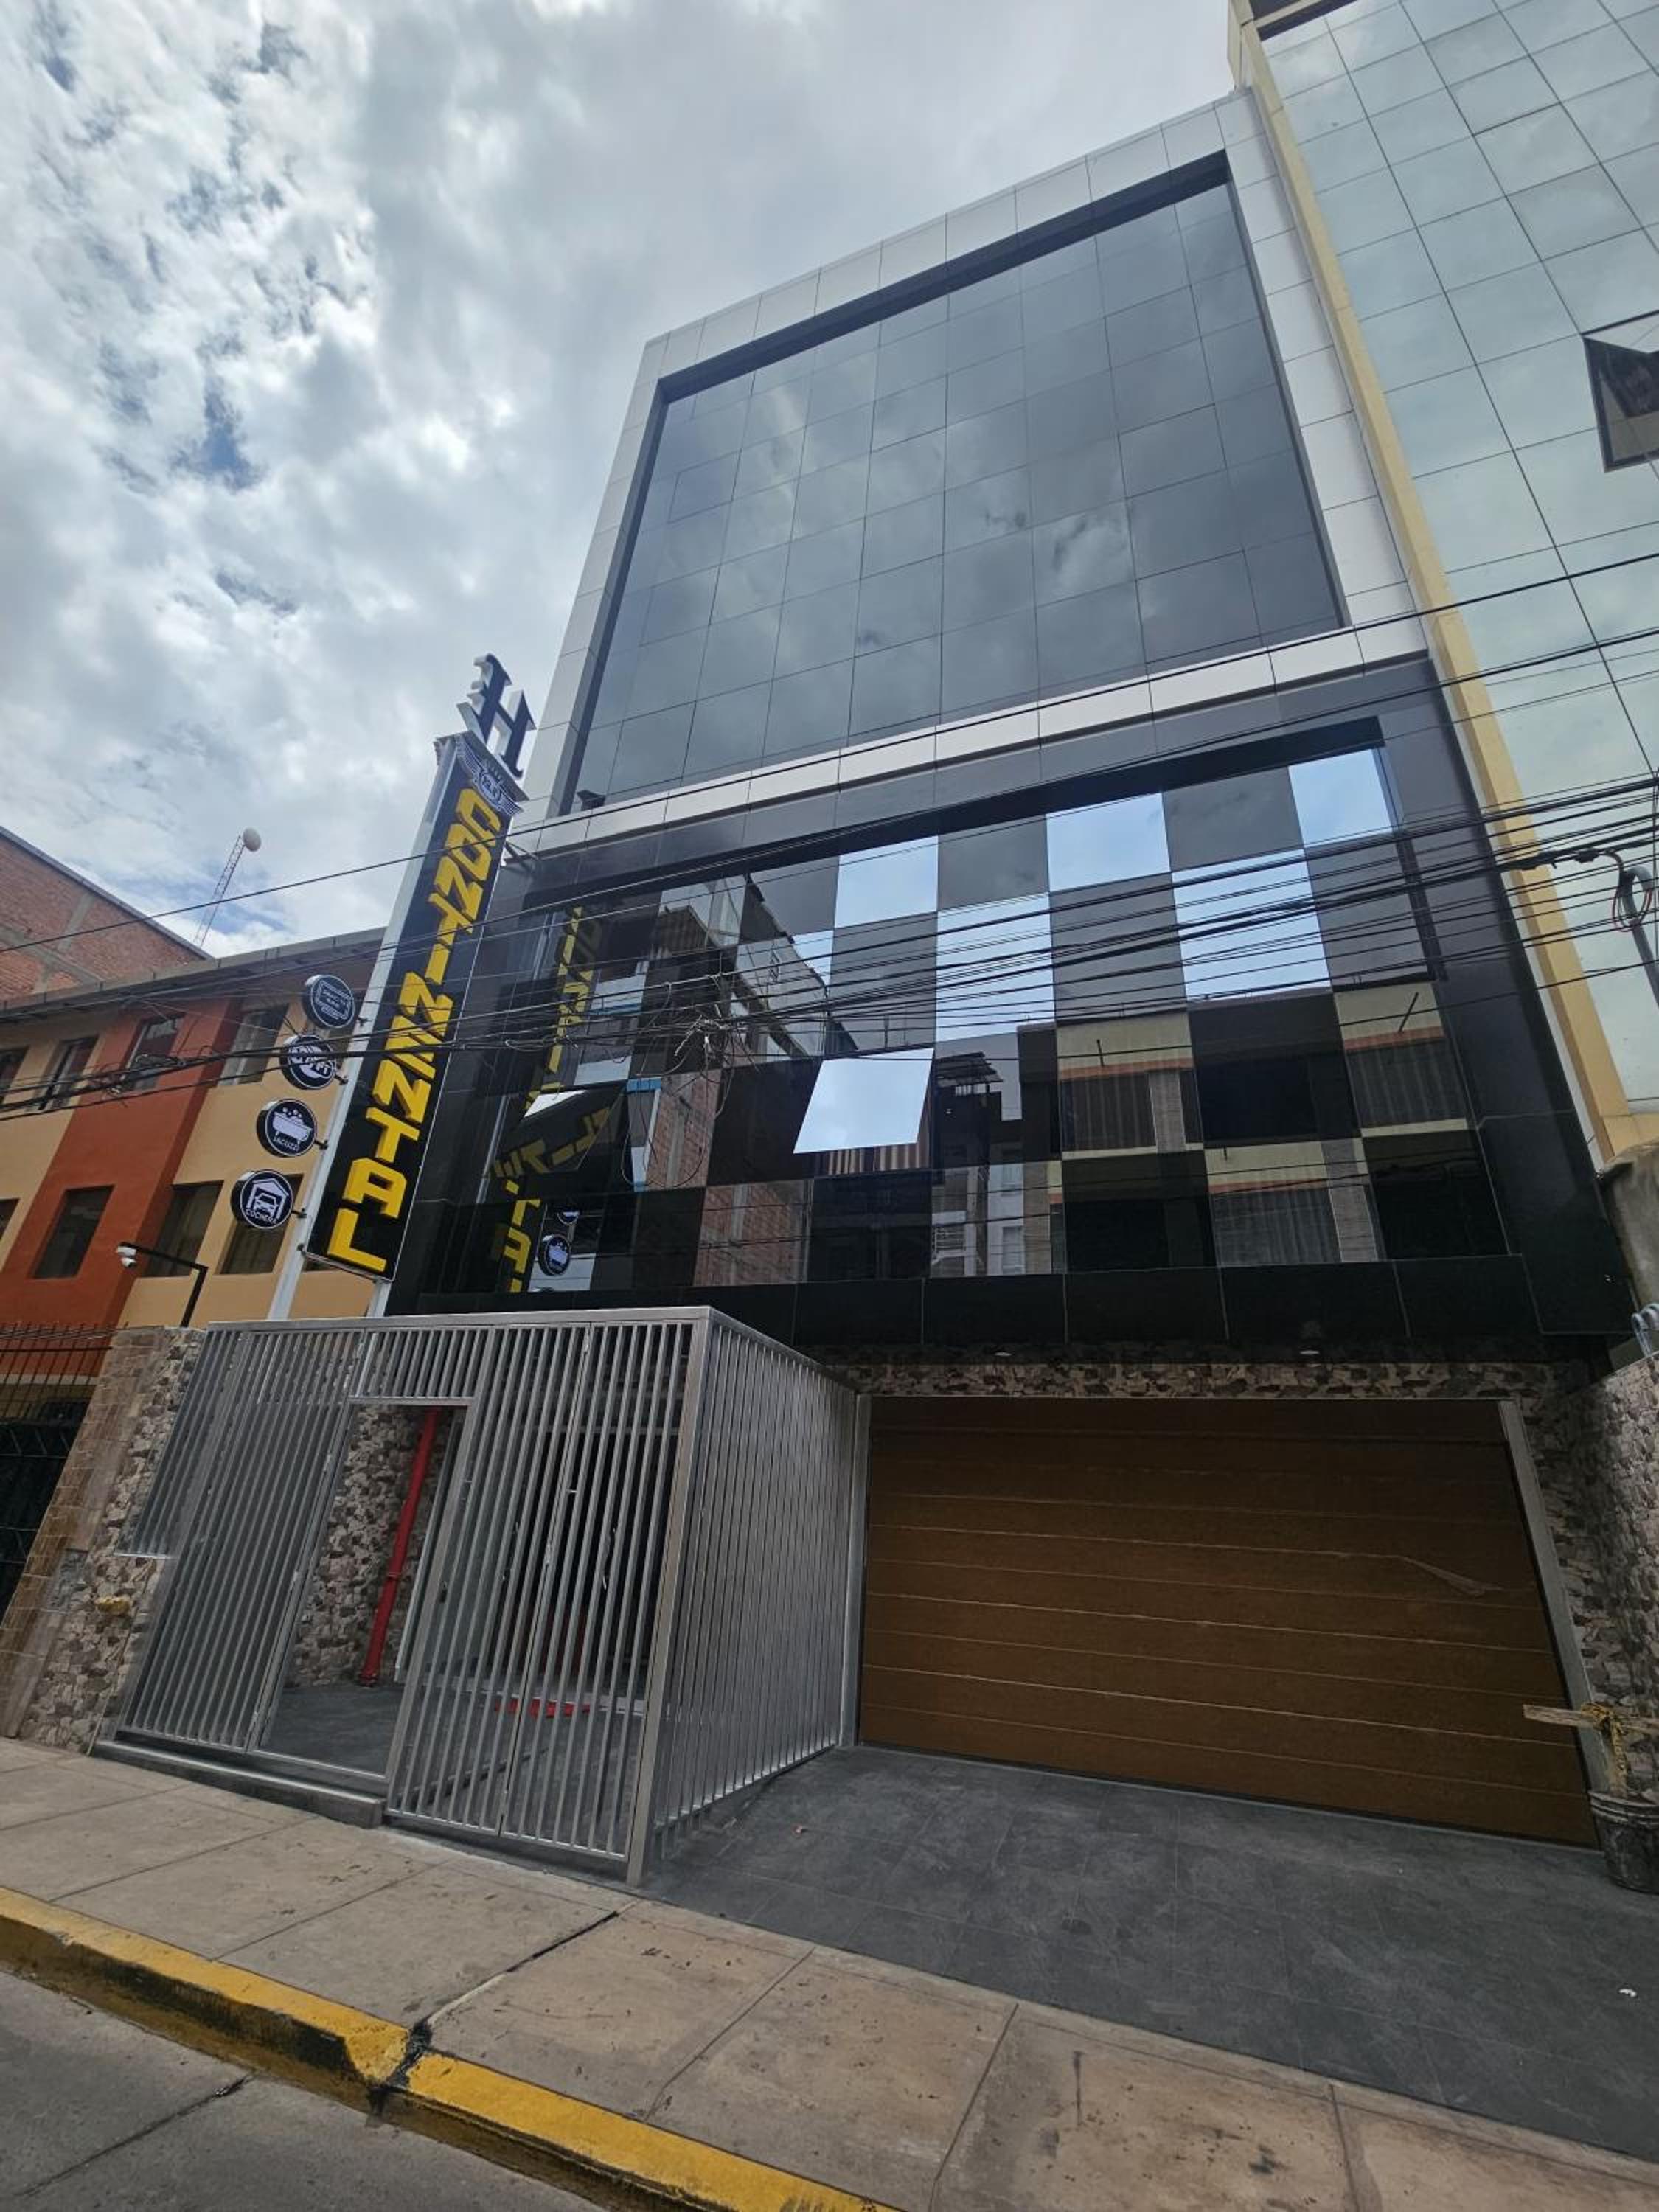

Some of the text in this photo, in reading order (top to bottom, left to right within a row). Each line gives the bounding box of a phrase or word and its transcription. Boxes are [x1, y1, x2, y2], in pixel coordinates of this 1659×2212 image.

[457, 653, 537, 779] H
[327, 788, 501, 1272] CONTINENTAL
[246, 1208, 276, 1224] COCHERA
